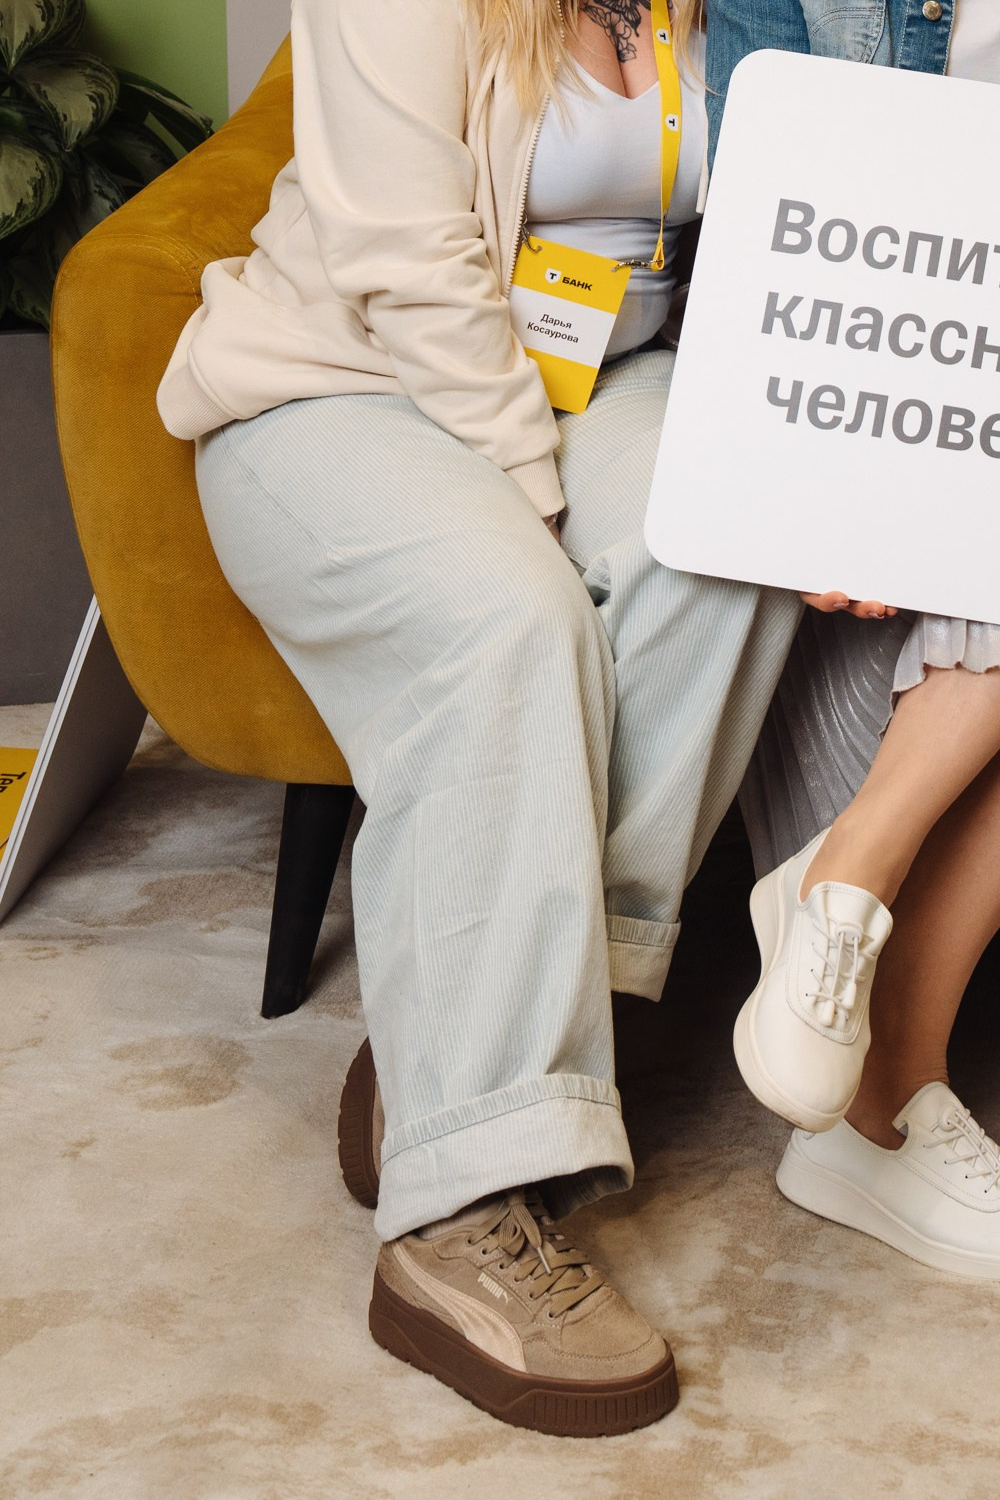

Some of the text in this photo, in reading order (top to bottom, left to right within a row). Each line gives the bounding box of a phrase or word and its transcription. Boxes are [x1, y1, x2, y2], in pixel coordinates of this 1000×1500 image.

[561, 276, 593, 291] БАНК
[540, 313, 572, 329] Дарья
[526, 321, 579, 343] Косаурова
[477, 1271, 504, 1300] PUMA
